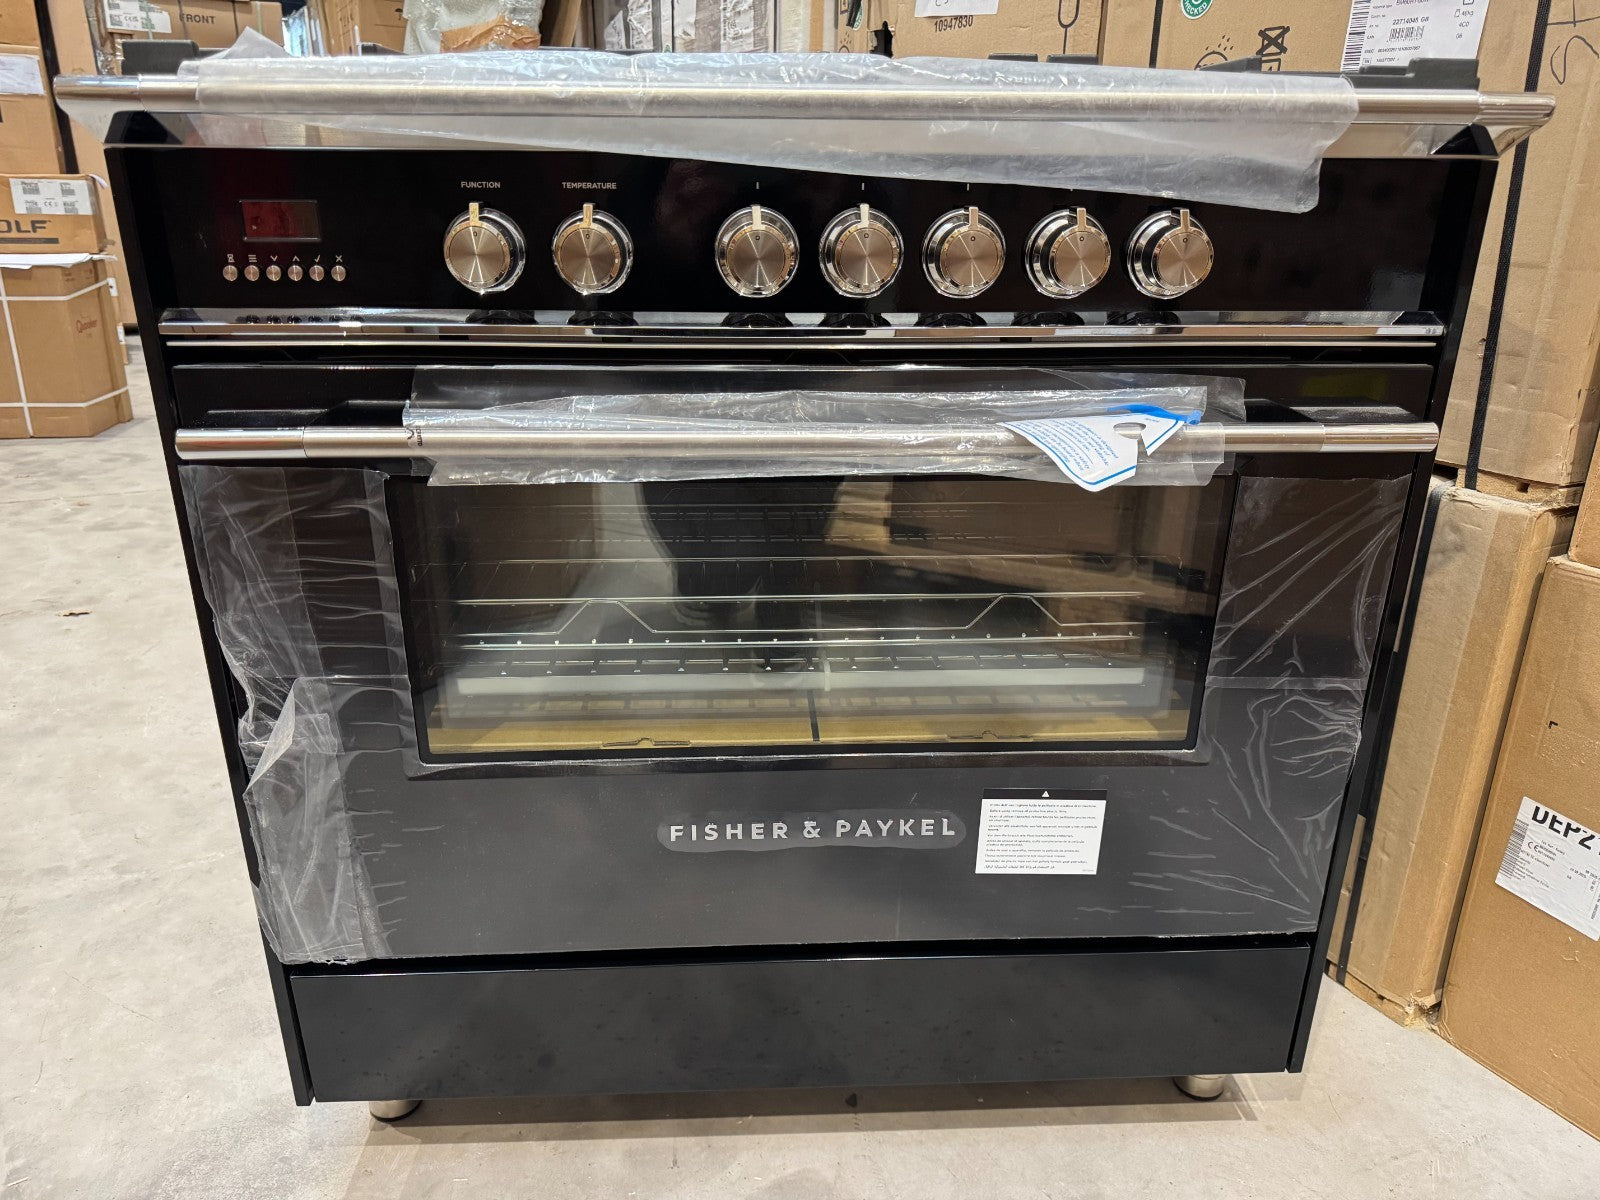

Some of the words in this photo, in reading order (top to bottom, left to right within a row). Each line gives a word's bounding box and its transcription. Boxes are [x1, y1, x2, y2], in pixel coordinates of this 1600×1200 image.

[1184, 0, 1208, 15] HECKED
[179, 13, 216, 25] FRONT
[934, 15, 974, 32] 10947830
[460, 181, 501, 189] FUNCTION
[561, 182, 617, 190] TEMPERATURE
[669, 822, 789, 842] FISHER
[802, 819, 821, 839] &
[834, 817, 956, 838] PAYKEL
